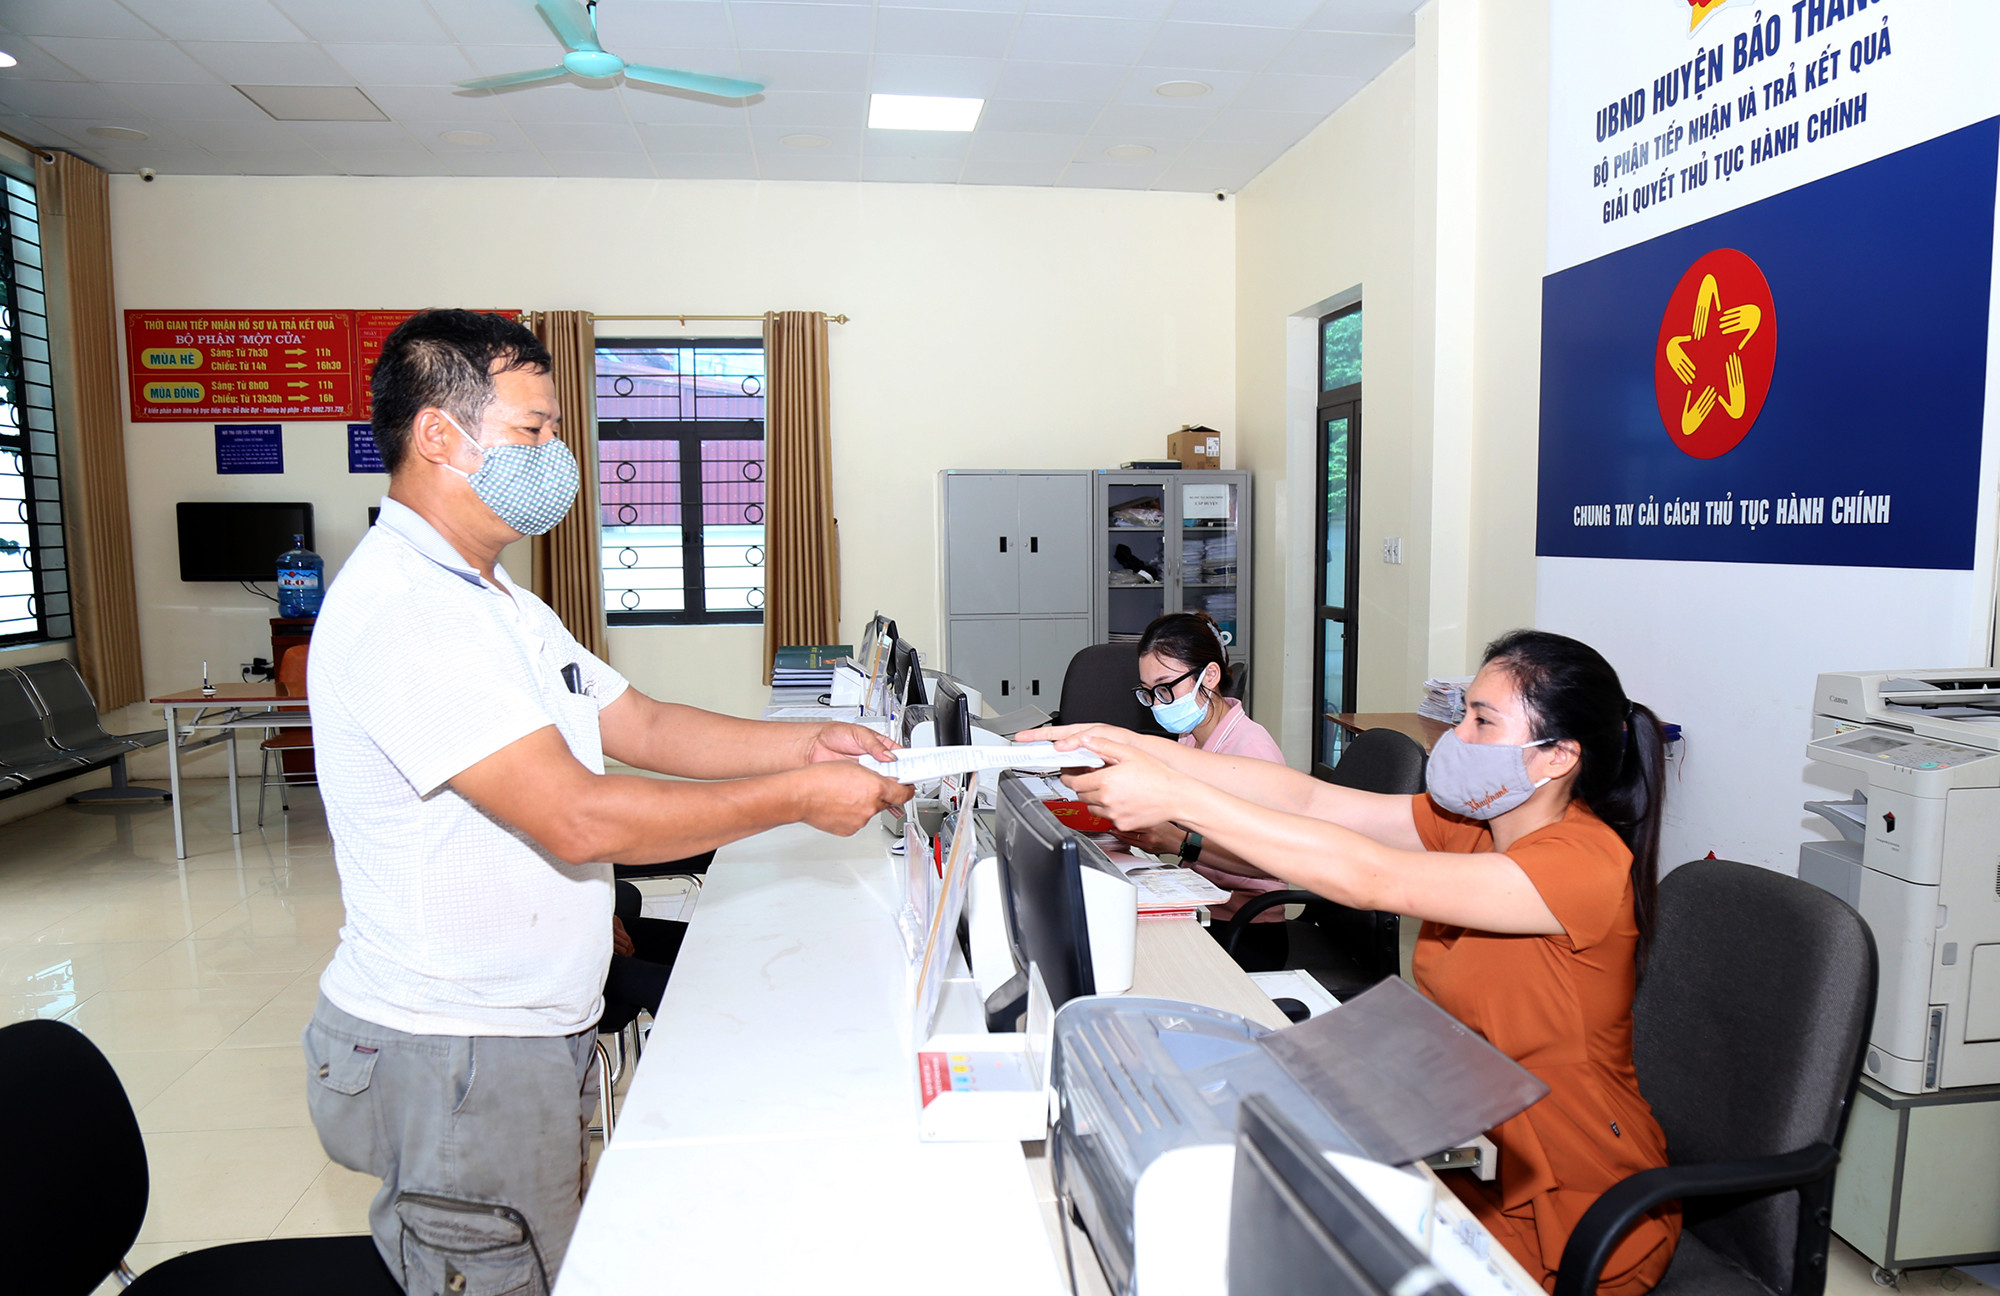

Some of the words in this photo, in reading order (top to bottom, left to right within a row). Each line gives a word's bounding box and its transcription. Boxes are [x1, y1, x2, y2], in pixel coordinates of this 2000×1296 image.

[1595, 87, 1646, 143] UBND
[1652, 43, 1724, 116] HUYỆN
[1733, 10, 1781, 75] BẢO
[1593, 155, 1609, 188] BỘ
[1614, 140, 1649, 180] PHẬN
[1654, 118, 1684, 162] TIẾP
[1688, 102, 1732, 146] NHẬN
[1738, 86, 1757, 122] VÀ
[1762, 62, 1797, 111] TRẢ
[1805, 44, 1841, 92] KẾT
[1849, 15, 1892, 74] QUẢ
[1602, 183, 1628, 225] GIẢI
[1632, 162, 1675, 212] QUYẾT
[1680, 150, 1708, 194] THỦ
[1714, 147, 1745, 181] TỤC
[1750, 120, 1799, 166] HÀNH
[1806, 92, 1868, 144] CHÍNH
[144, 319, 164, 330] THỜI
[166, 320, 188, 330] GIAN
[190, 318, 208, 330] TIẾP
[212, 319, 236, 332] NHẬN
[238, 318, 250, 330] HỒ
[253, 320, 265, 330] SƠ
[267, 319, 277, 330] VÀ
[280, 317, 297, 330] TRẢ
[299, 318, 314, 330] KẾT
[317, 317, 335, 330] QUẢ
[176, 333, 194, 346] BỘ
[198, 333, 235, 346] PHẬN
[150, 352, 176, 365] MÙA
[180, 352, 195, 365] HÈ
[211, 348, 234, 358] Sáng:
[236, 348, 246, 357] Từ
[248, 348, 268, 357] 7h30
[316, 348, 331, 356] 11h
[239, 361, 249, 370] Từ
[252, 362, 266, 370] 14h
[317, 361, 341, 370] 16h30
[150, 386, 171, 398] MÙA
[174, 386, 199, 398] ĐÔNG
[212, 381, 235, 390] Sáng:
[237, 381, 246, 390] Từ
[249, 381, 269, 390] 8h00
[318, 381, 333, 389] 11h
[240, 394, 250, 403] Từ
[253, 394, 282, 403] 13h30h
[319, 394, 334, 402] 16h
[1573, 504, 1610, 528] CHUNG
[1615, 503, 1634, 527] TAY
[1638, 495, 1659, 527] CẢI
[1663, 496, 1700, 527] CÁCH
[1705, 492, 1734, 526] THỦ
[1739, 499, 1770, 531] TỤC
[1776, 492, 1824, 525] HÀNH
[1831, 490, 1891, 525] CHÍNH
[1829, 695, 1848, 705] Canon
